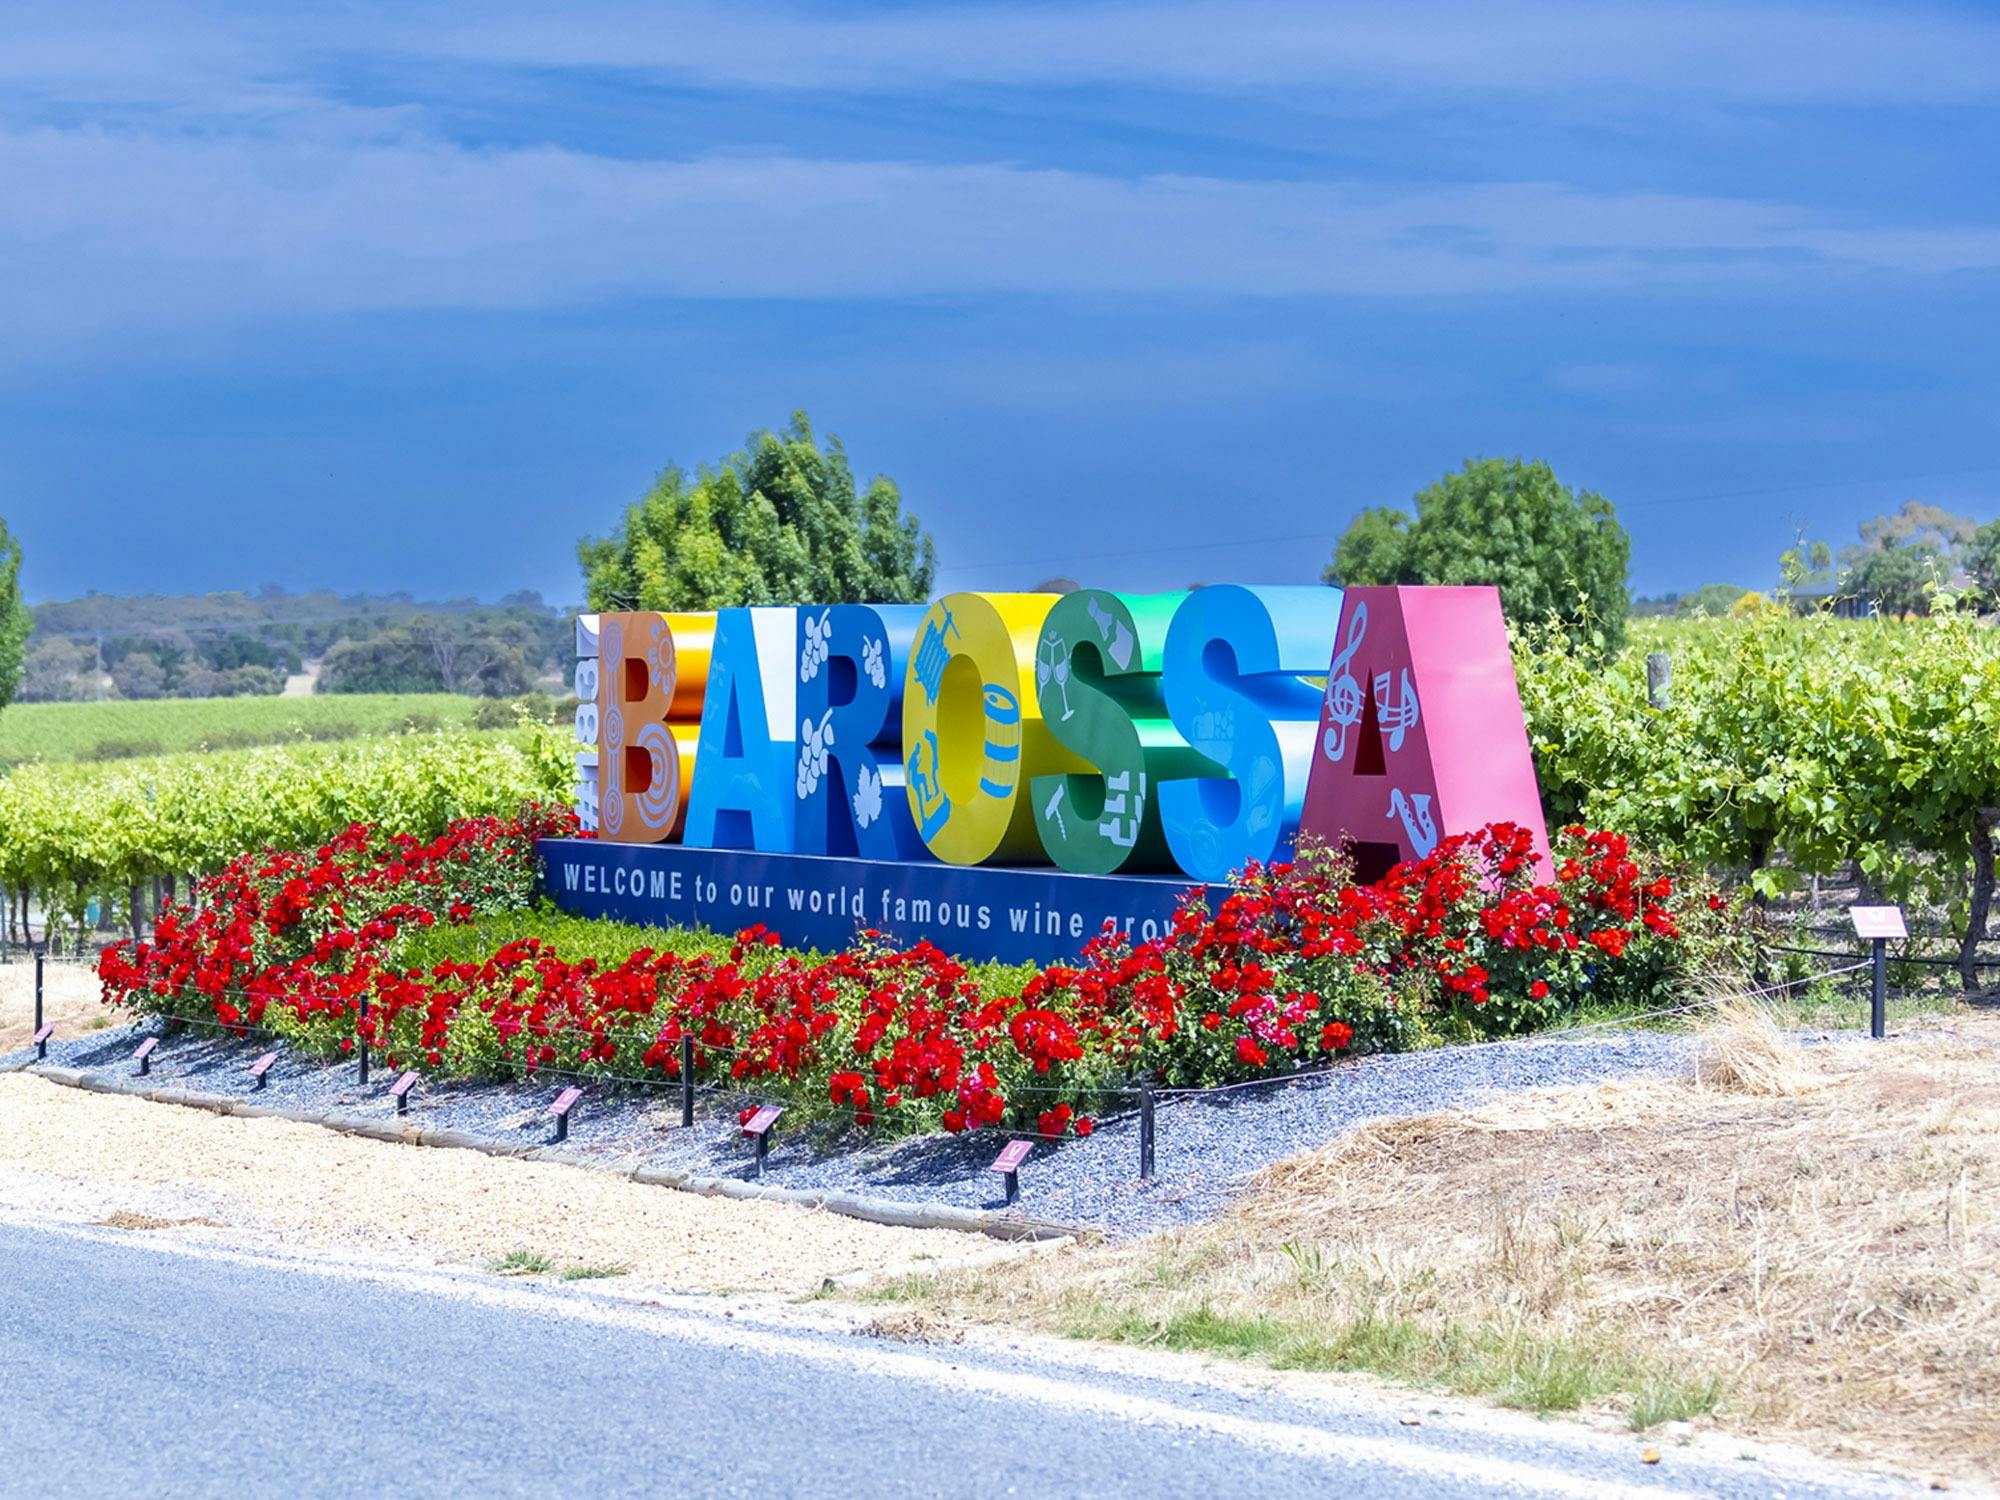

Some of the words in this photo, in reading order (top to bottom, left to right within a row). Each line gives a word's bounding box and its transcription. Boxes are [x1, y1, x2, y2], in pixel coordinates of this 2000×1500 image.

[598, 584, 1550, 885] BAROSSA
[564, 863, 683, 900] WELCOME
[695, 874, 717, 904] to
[730, 883, 774, 909] our
[788, 886, 865, 918] world
[881, 888, 992, 932] famous
[1009, 902, 1084, 938] wine
